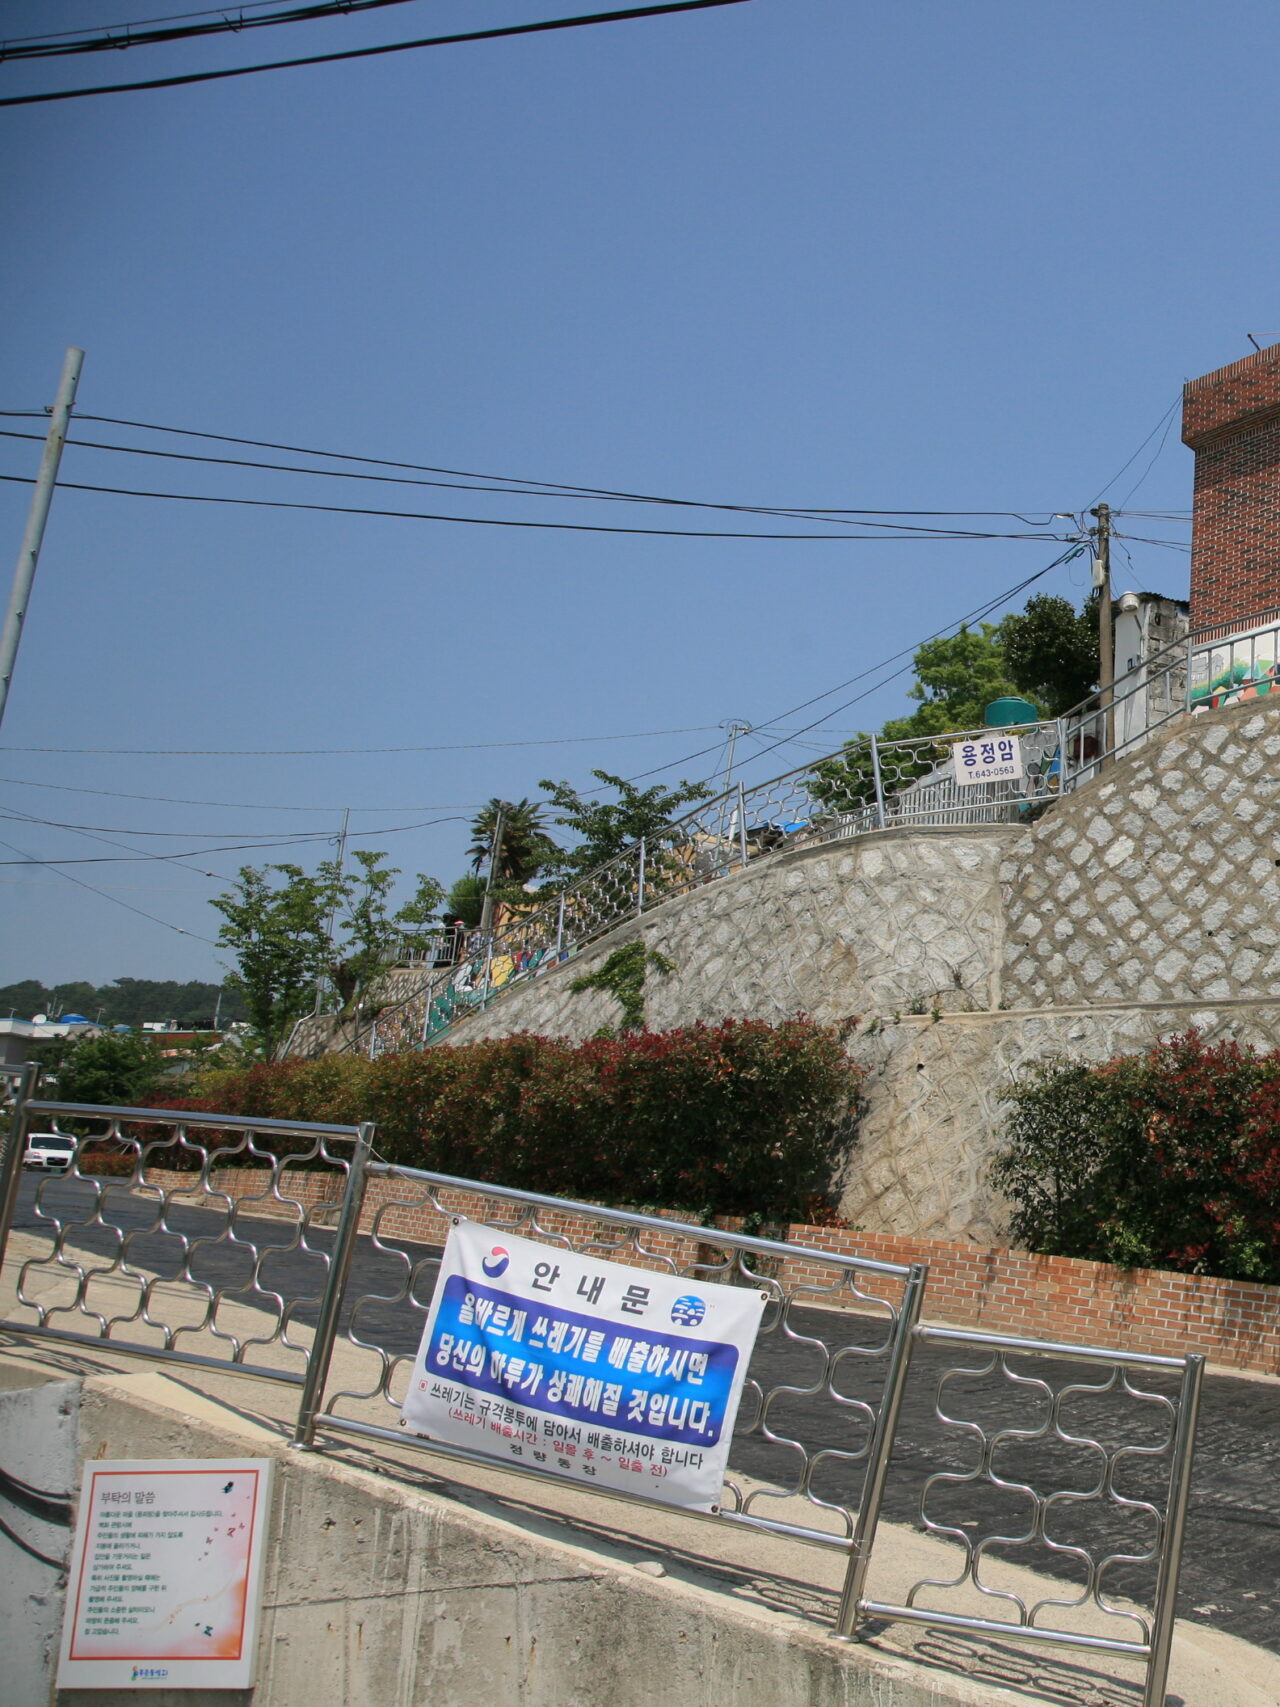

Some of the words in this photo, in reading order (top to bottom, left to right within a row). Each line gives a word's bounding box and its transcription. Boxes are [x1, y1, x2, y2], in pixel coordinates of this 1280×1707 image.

[962, 740, 1014, 766] 용정암
[458, 1292, 527, 1343] 올바르게
[529, 1316, 606, 1363] 쓰레기를
[608, 1336, 709, 1385] 배출하시면
[436, 1332, 487, 1377] 당신의
[490, 1350, 544, 1396] 하루가
[547, 1370, 623, 1417] 상쾌해질
[627, 1389, 714, 1437] 것입니다.
[430, 1383, 476, 1411] 쓰레기는
[479, 1399, 538, 1433] 규격봉투에
[544, 1420, 581, 1444] 담아서
[587, 1432, 655, 1461] 배출하셔야
[661, 1447, 703, 1470] 합니다
[448, 1407, 486, 1429] (쓰레기
[490, 1422, 538, 1446] 배출시간
[552, 1440, 577, 1457] 일몰
[583, 1448, 595, 1461] 후
[618, 1457, 643, 1473] 일출
[101, 1491, 132, 1505] 부탁의
[134, 1491, 156, 1505] 말씀
